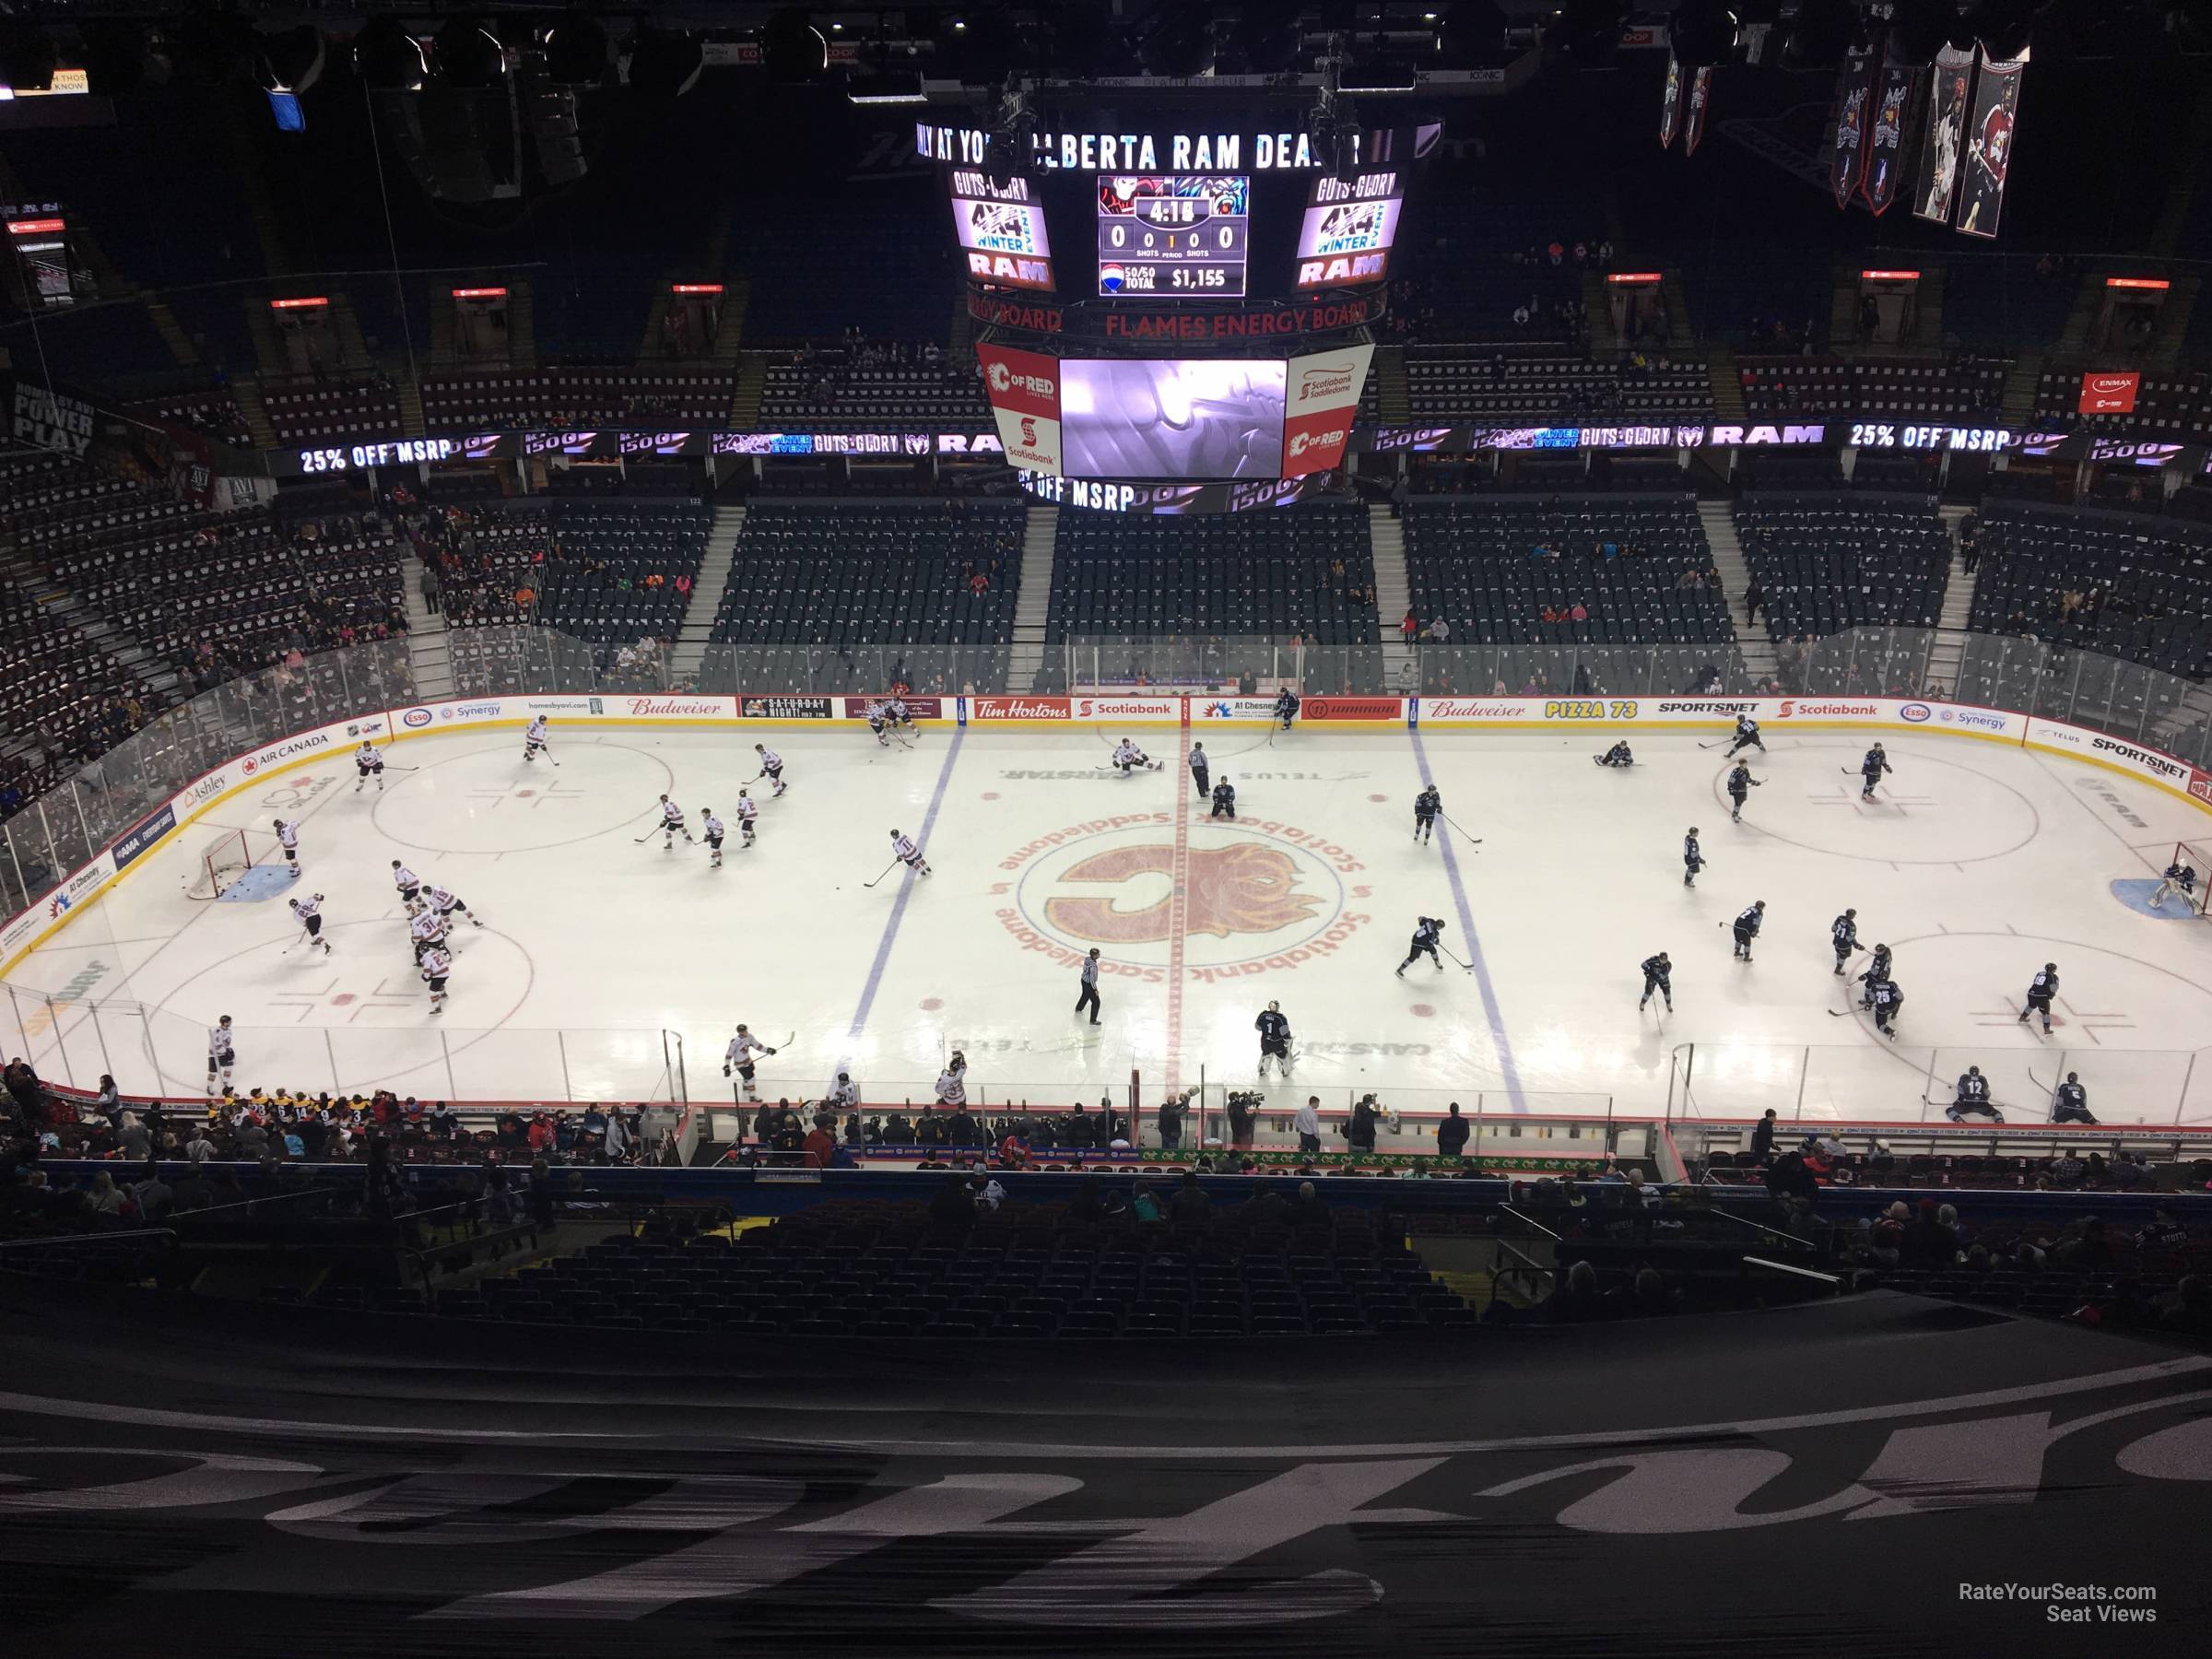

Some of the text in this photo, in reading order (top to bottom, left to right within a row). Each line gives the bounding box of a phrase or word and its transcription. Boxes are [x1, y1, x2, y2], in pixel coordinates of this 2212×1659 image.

[937, 128, 953, 160] AT
[1173, 135, 1241, 170] RAM
[1020, 209, 1033, 253] EVENT
[1371, 203, 1385, 247] EVENT
[977, 235, 1023, 252] WINTER
[1112, 225, 1125, 248] 0
[1144, 232, 1154, 248] 0
[1189, 232, 1199, 248] 0
[1218, 226, 1233, 249] 0
[1318, 235, 1368, 253] WINTER
[968, 253, 1050, 283] RAM
[1124, 266, 1156, 277] 50/50
[1298, 253, 1386, 287] RAM
[1125, 277, 1155, 289] TOTAL
[1172, 268, 1225, 288] $1,155
[999, 304, 1063, 332] BOARD
[1106, 301, 1367, 339] FLAMES ENERGY BOARD
[1011, 375, 1025, 387] OF
[1026, 376, 1054, 394] RED
[1310, 384, 1350, 398] Saddledome
[1312, 375, 1351, 390] Scotiabank
[15, 394, 93, 438] POWER
[14, 416, 91, 457] PLAY
[1309, 438, 1321, 446] OF
[1321, 429, 1344, 444] RED
[1535, 438, 1579, 448] EVENT
[1712, 426, 1825, 444] RAM
[1851, 425, 2010, 452] 25% OFF MSRP
[300, 439, 451, 472] 25% OFF MSRP
[771, 443, 812, 453] EVENT
[1008, 446, 1054, 465] Scotiabank
[1073, 479, 1135, 512] MSRP
[456, 704, 501, 717] Synergy
[528, 701, 589, 711] homesbyavi.com
[627, 698, 723, 715] Budweiser
[770, 708, 800, 717] NIGHT!
[978, 700, 1006, 718] Tim
[1008, 700, 1067, 718] Hortons
[1099, 704, 1171, 714] Scotiabank
[1429, 700, 1525, 718] Budweiser
[1545, 700, 1638, 718] PIZZA 73
[1659, 702, 1759, 713] SPORTSNET
[1799, 704, 1877, 716] Scotiabank
[1905, 708, 1926, 718] Esso
[407, 712, 428, 723] Esso
[1959, 712, 2006, 729] Synergy
[2053, 732, 2080, 743] TELUS
[260, 735, 329, 766] AIR CANADA
[2092, 737, 2189, 781] SPORTSNET
[194, 774, 226, 801] Ashley
[1192, 911, 1373, 984] Scotiabank
[1876, 991, 1890, 1004] 25
[1968, 1082, 1982, 1095] 12
